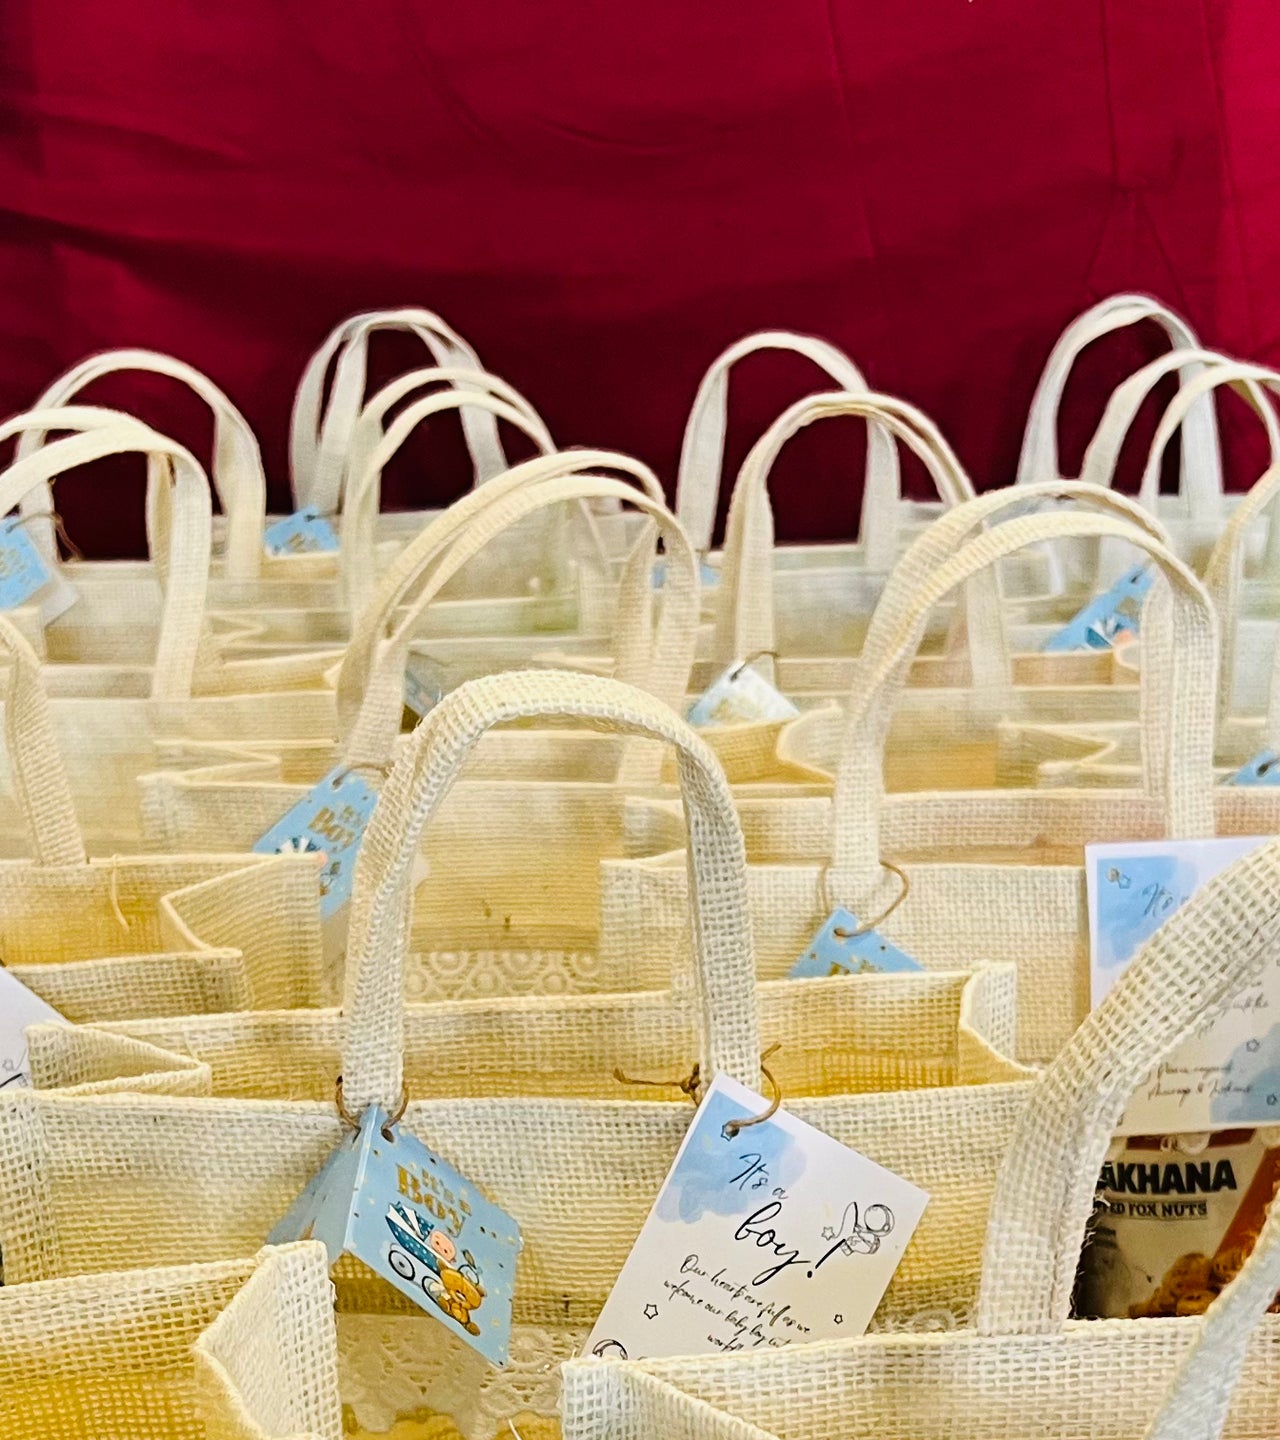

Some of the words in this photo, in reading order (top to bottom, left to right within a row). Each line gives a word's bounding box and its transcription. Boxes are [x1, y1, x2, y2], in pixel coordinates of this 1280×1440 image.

[1096, 1159, 1238, 1194] AKHANA
[772, 1187, 789, 1200] a
[1161, 1201, 1208, 1217] NUTS
[735, 1201, 846, 1286] boy!
